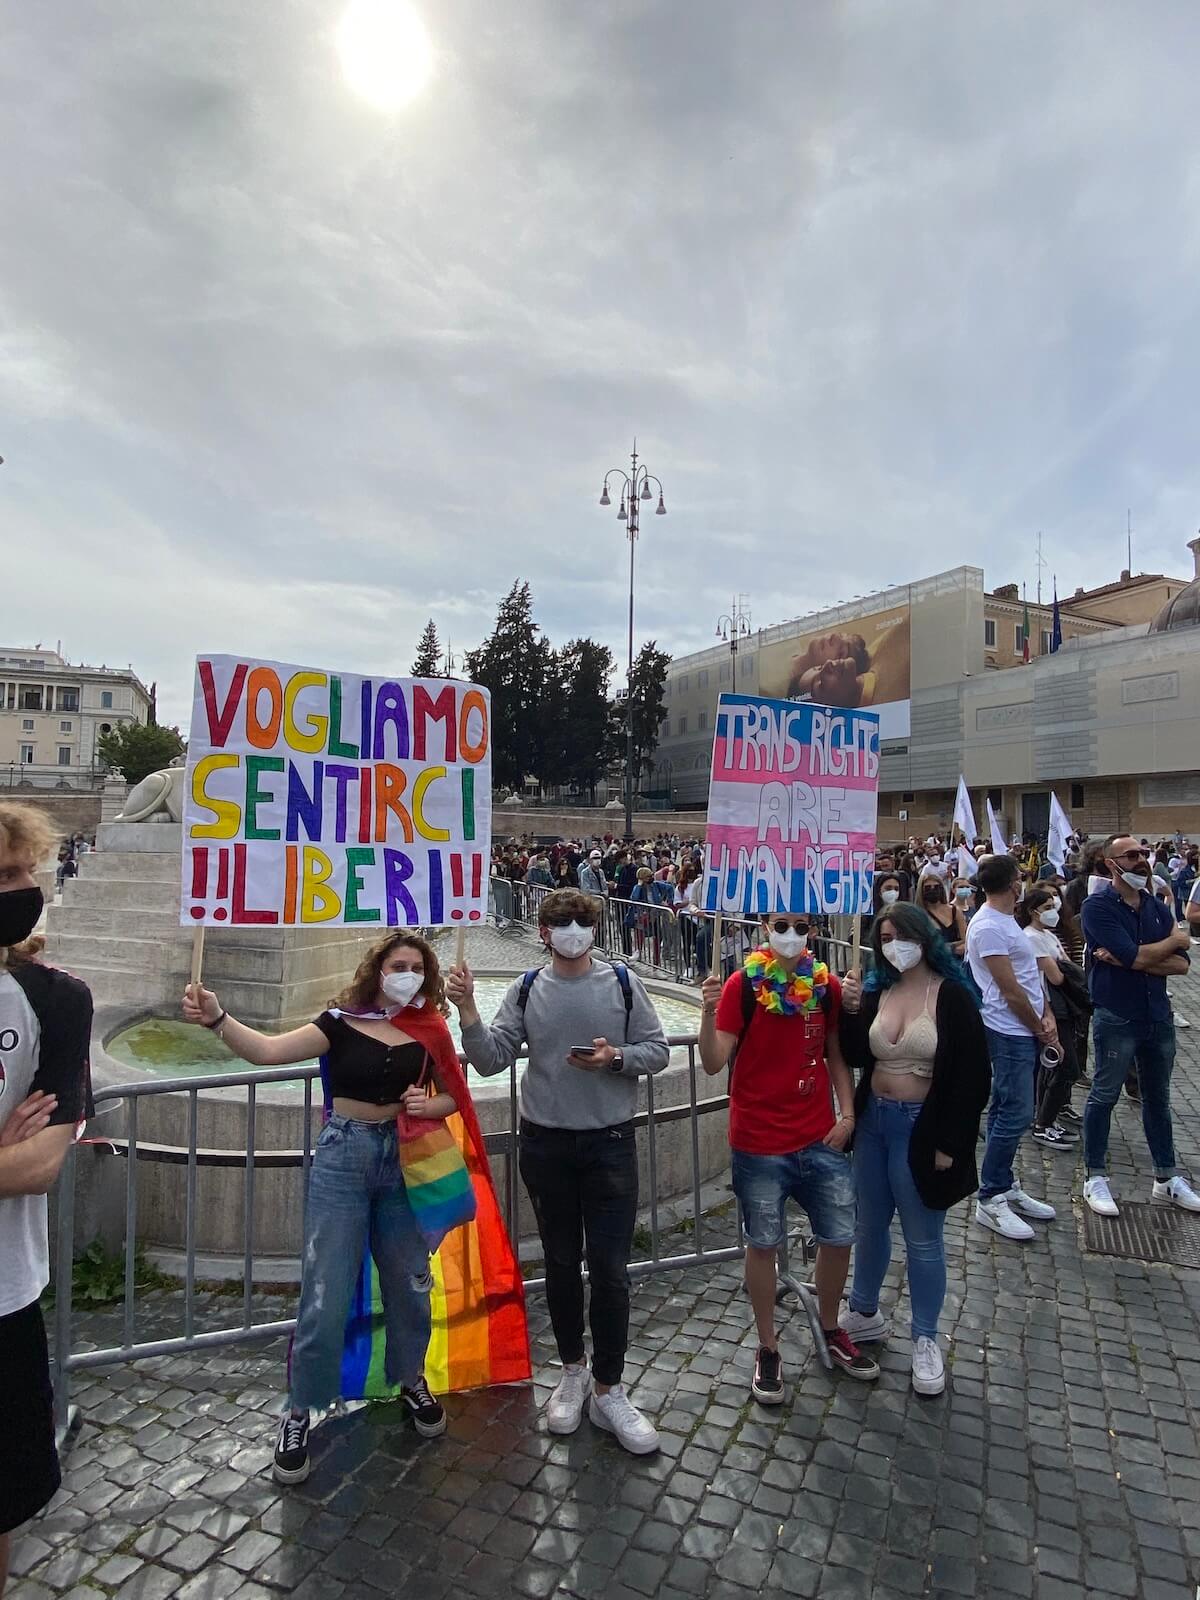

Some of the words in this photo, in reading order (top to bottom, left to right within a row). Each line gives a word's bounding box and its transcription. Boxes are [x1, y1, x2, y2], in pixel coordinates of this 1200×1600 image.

[197, 661, 489, 764] VOGLIAMO
[717, 703, 802, 773] TRANS
[189, 753, 475, 843] SENTIRCI
[757, 780, 849, 846] ARE
[700, 842, 793, 914] HUMAN
